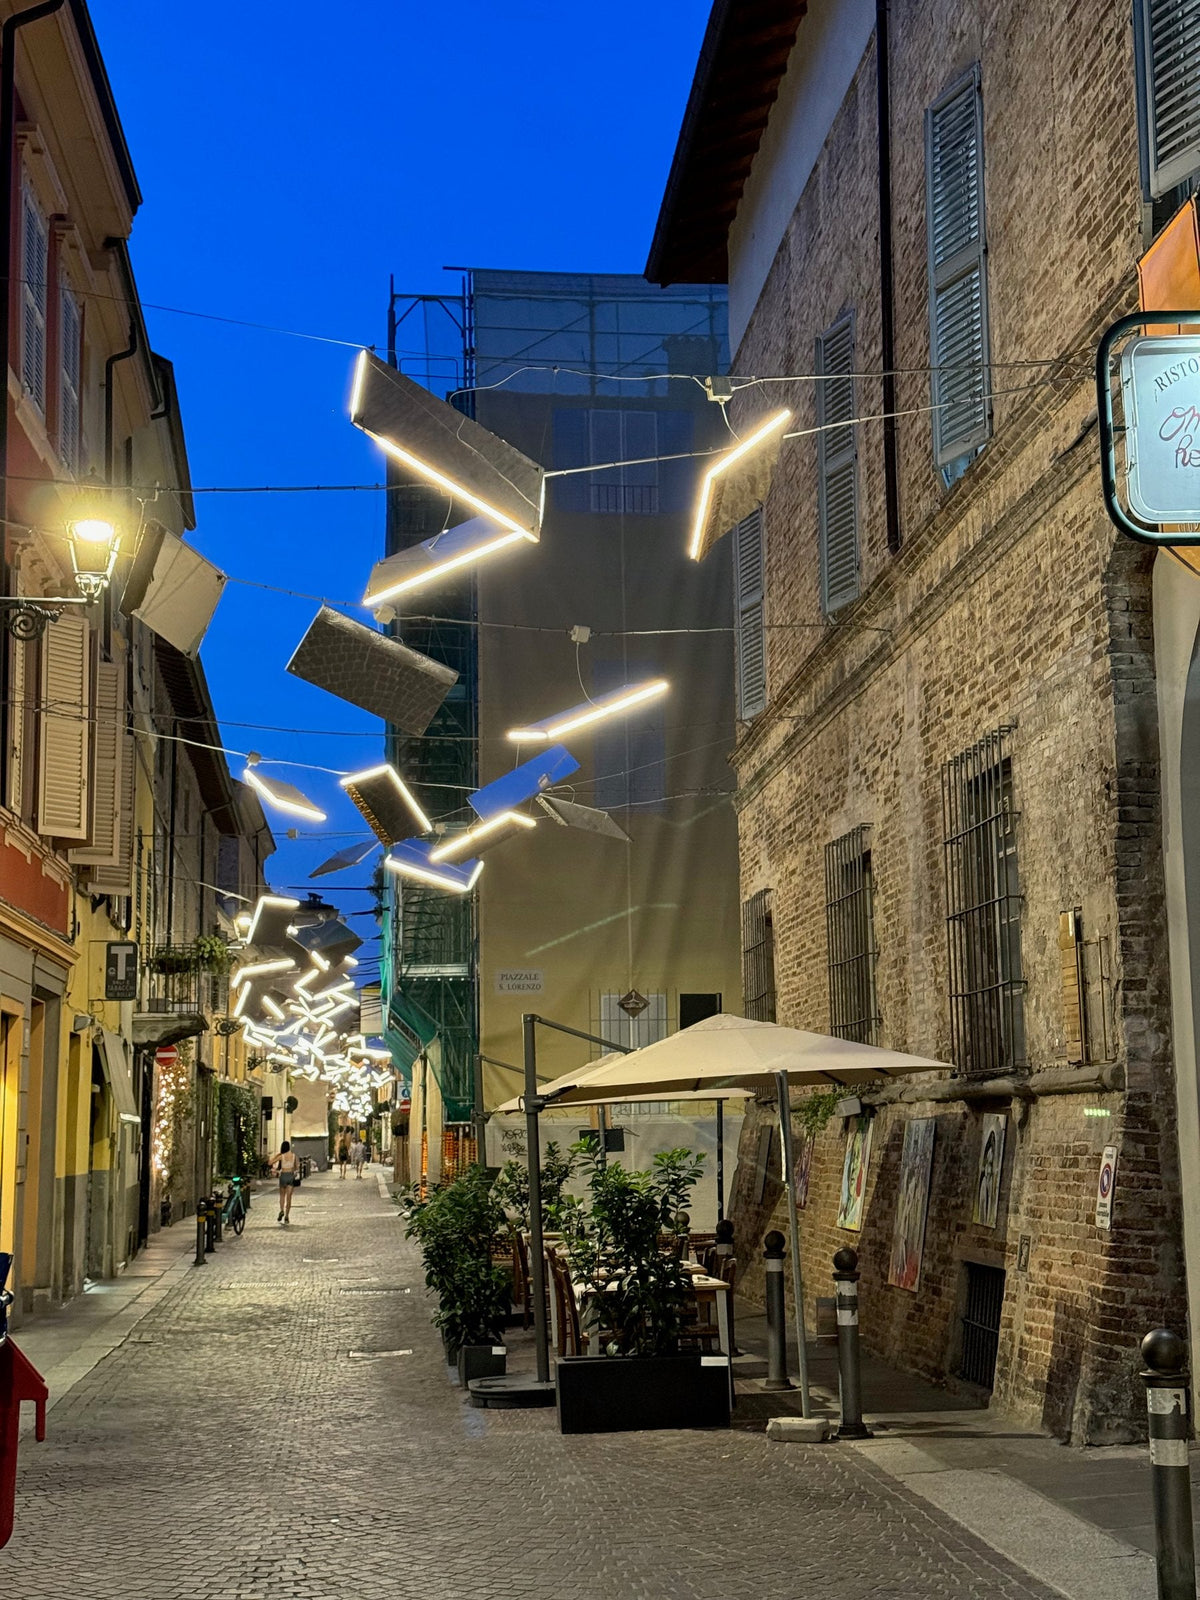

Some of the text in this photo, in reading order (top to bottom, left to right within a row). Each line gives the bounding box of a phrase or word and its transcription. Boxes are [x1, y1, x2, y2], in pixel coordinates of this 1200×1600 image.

[1153, 357, 1200, 392] RISTO
[110, 946, 133, 980] T
[500, 973, 539, 981] PIAZZALE
[507, 983, 542, 991] LORENZO
